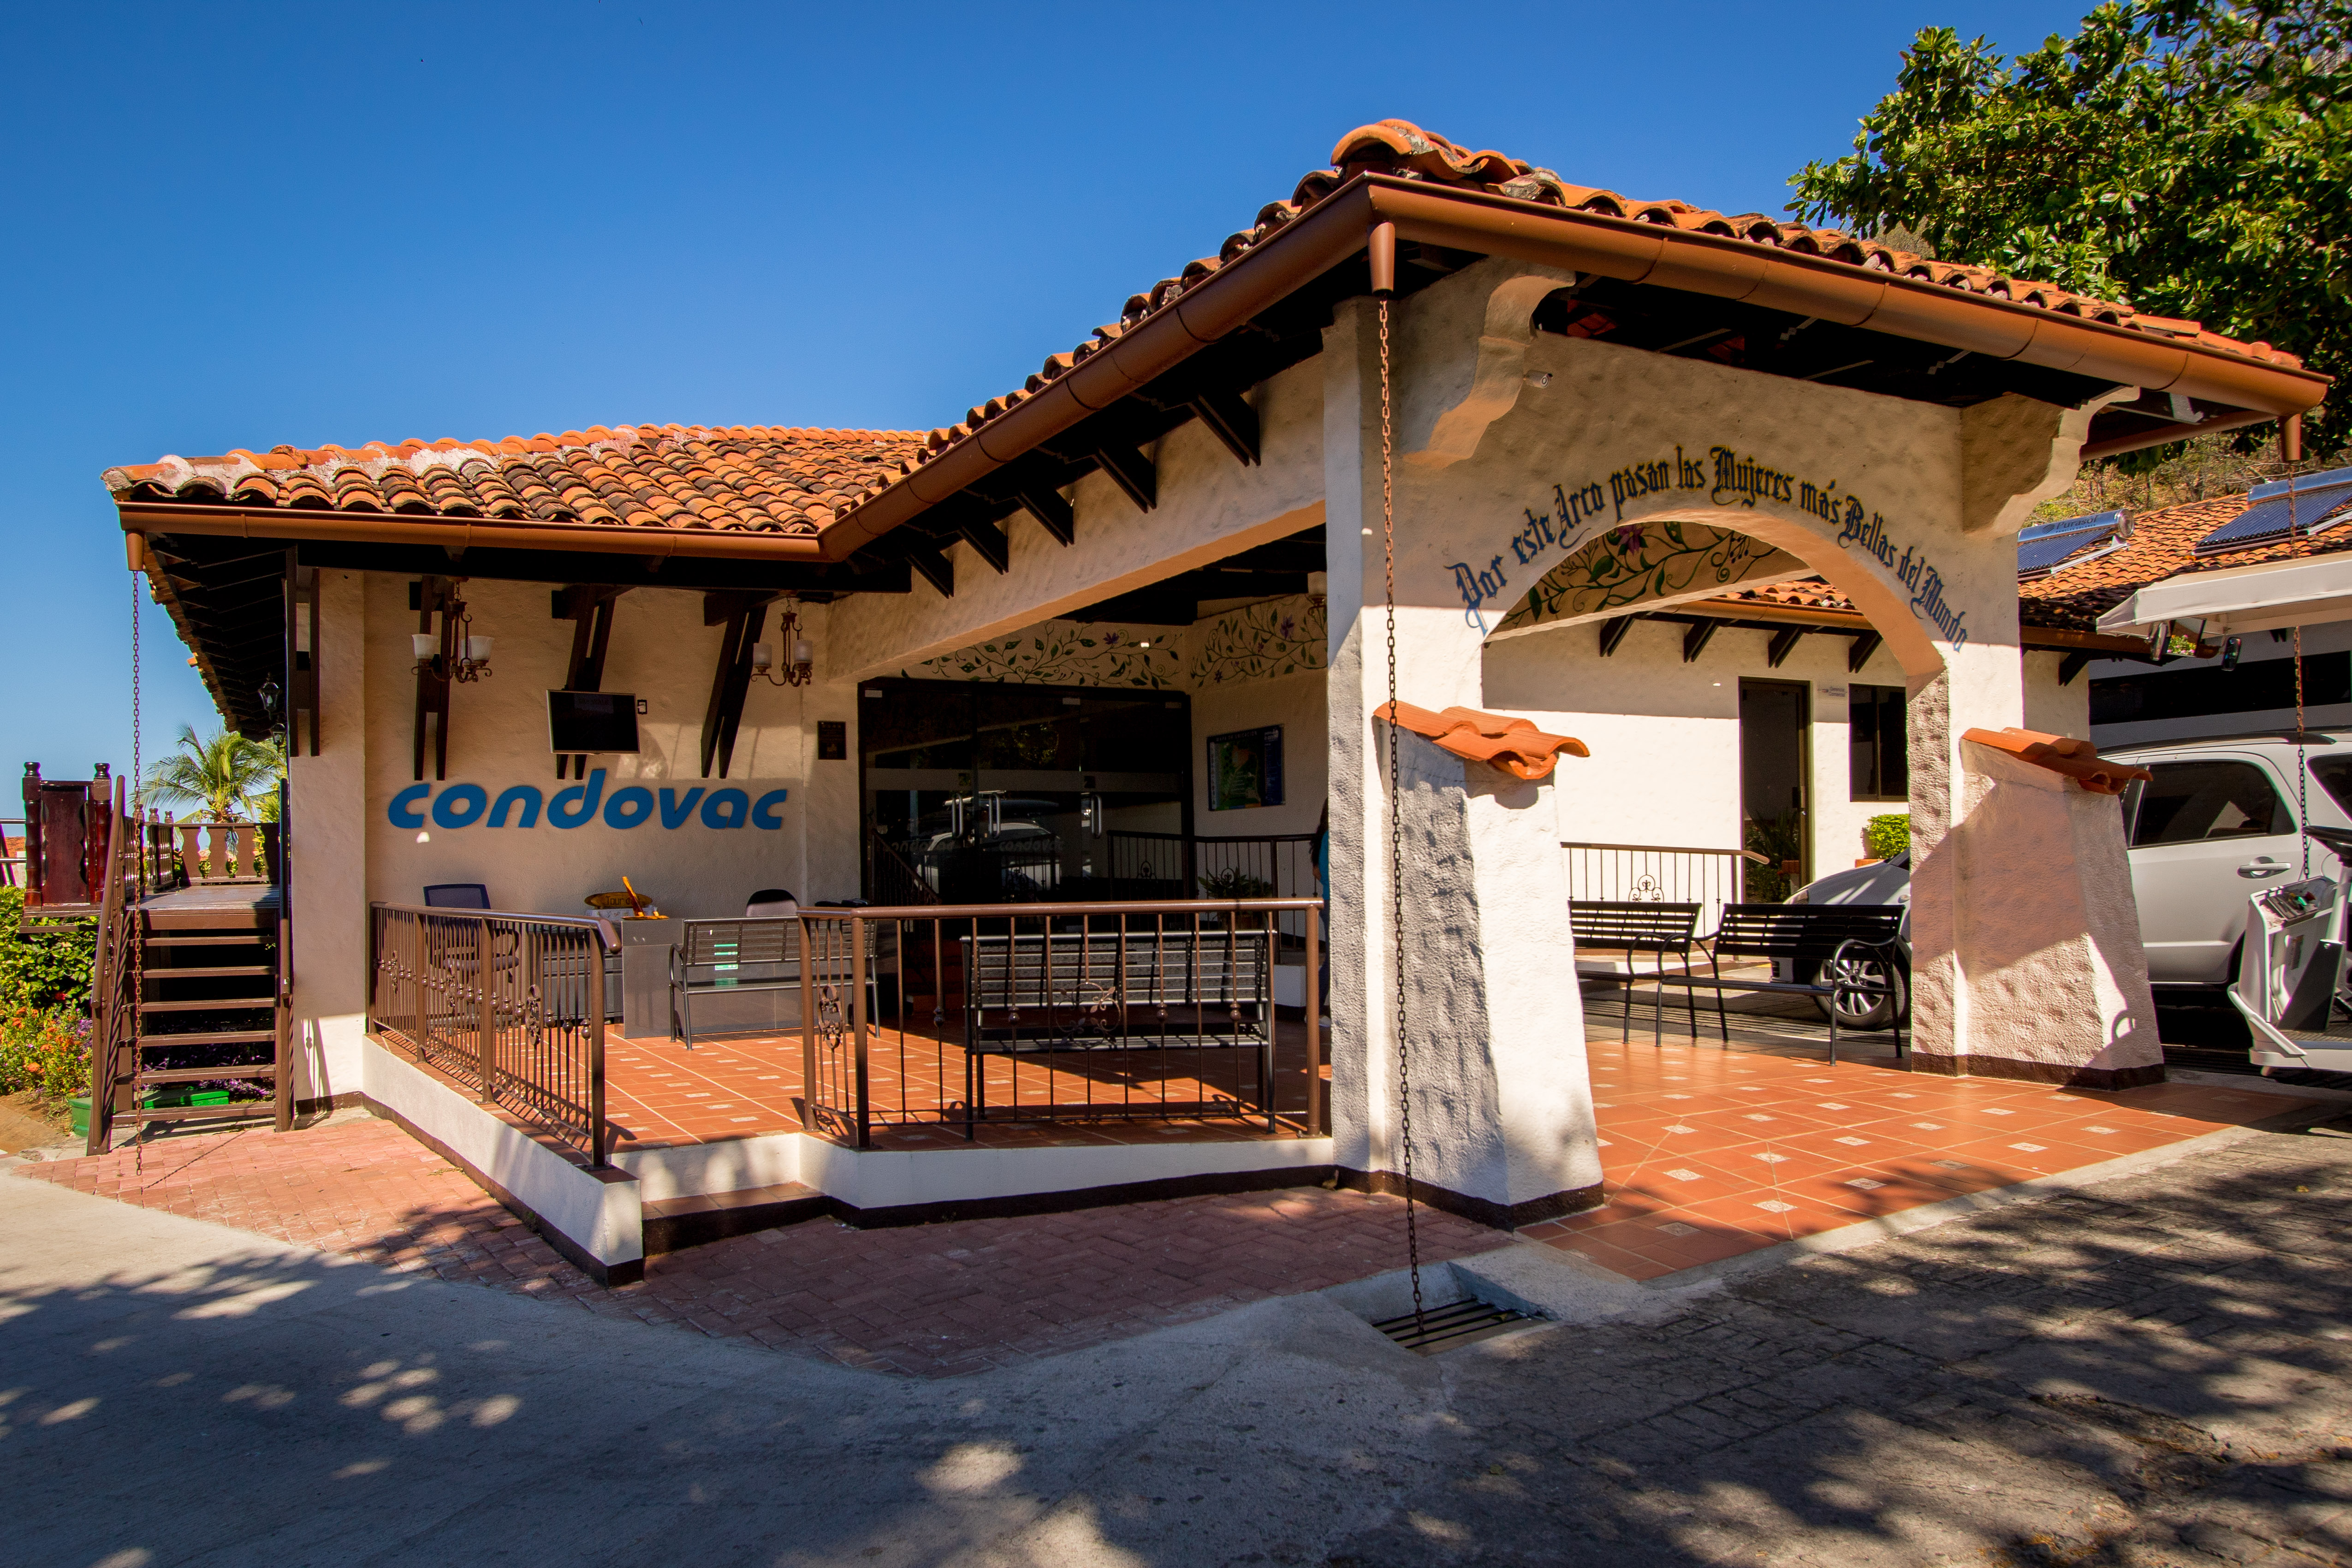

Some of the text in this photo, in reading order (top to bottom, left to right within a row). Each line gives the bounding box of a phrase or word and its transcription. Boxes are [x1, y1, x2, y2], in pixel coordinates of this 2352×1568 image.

[2056, 515, 2099, 530] Purasol
[1444, 444, 1968, 653] Por este Arco pasan las Mujeres más Bellas del Mundo
[387, 768, 788, 830] condovac
[605, 896, 624, 905] Tour
